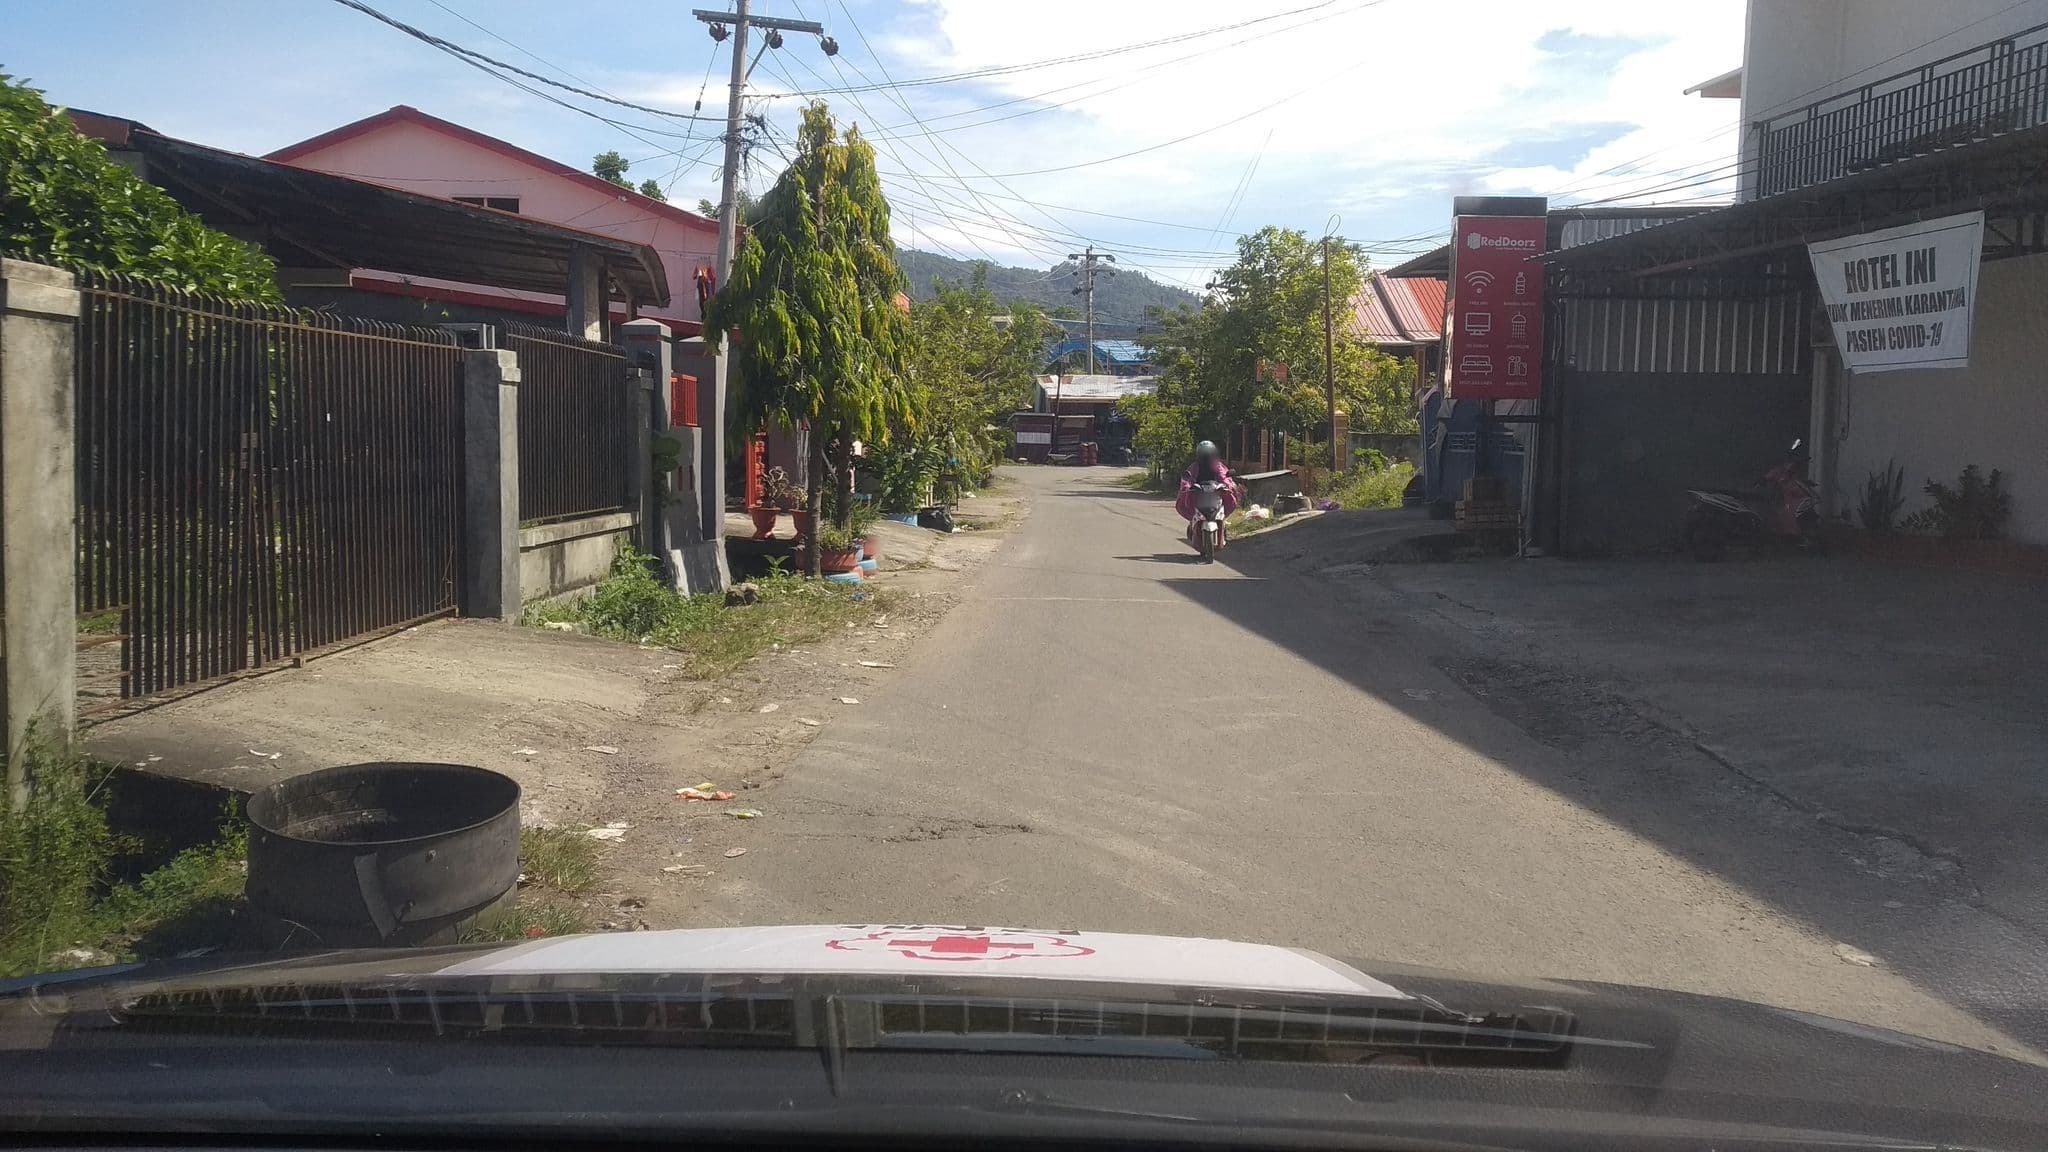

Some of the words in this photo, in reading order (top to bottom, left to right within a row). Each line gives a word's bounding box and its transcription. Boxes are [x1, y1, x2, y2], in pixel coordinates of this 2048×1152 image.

[1481, 236, 1536, 247] RedDoorz
[1844, 253, 1901, 294] HOTEL
[1905, 247, 1936, 285] INI
[1850, 297, 1904, 321] MENERIMA
[1846, 328, 1886, 352] PASIEN
[1887, 321, 1943, 350] COVID-19
